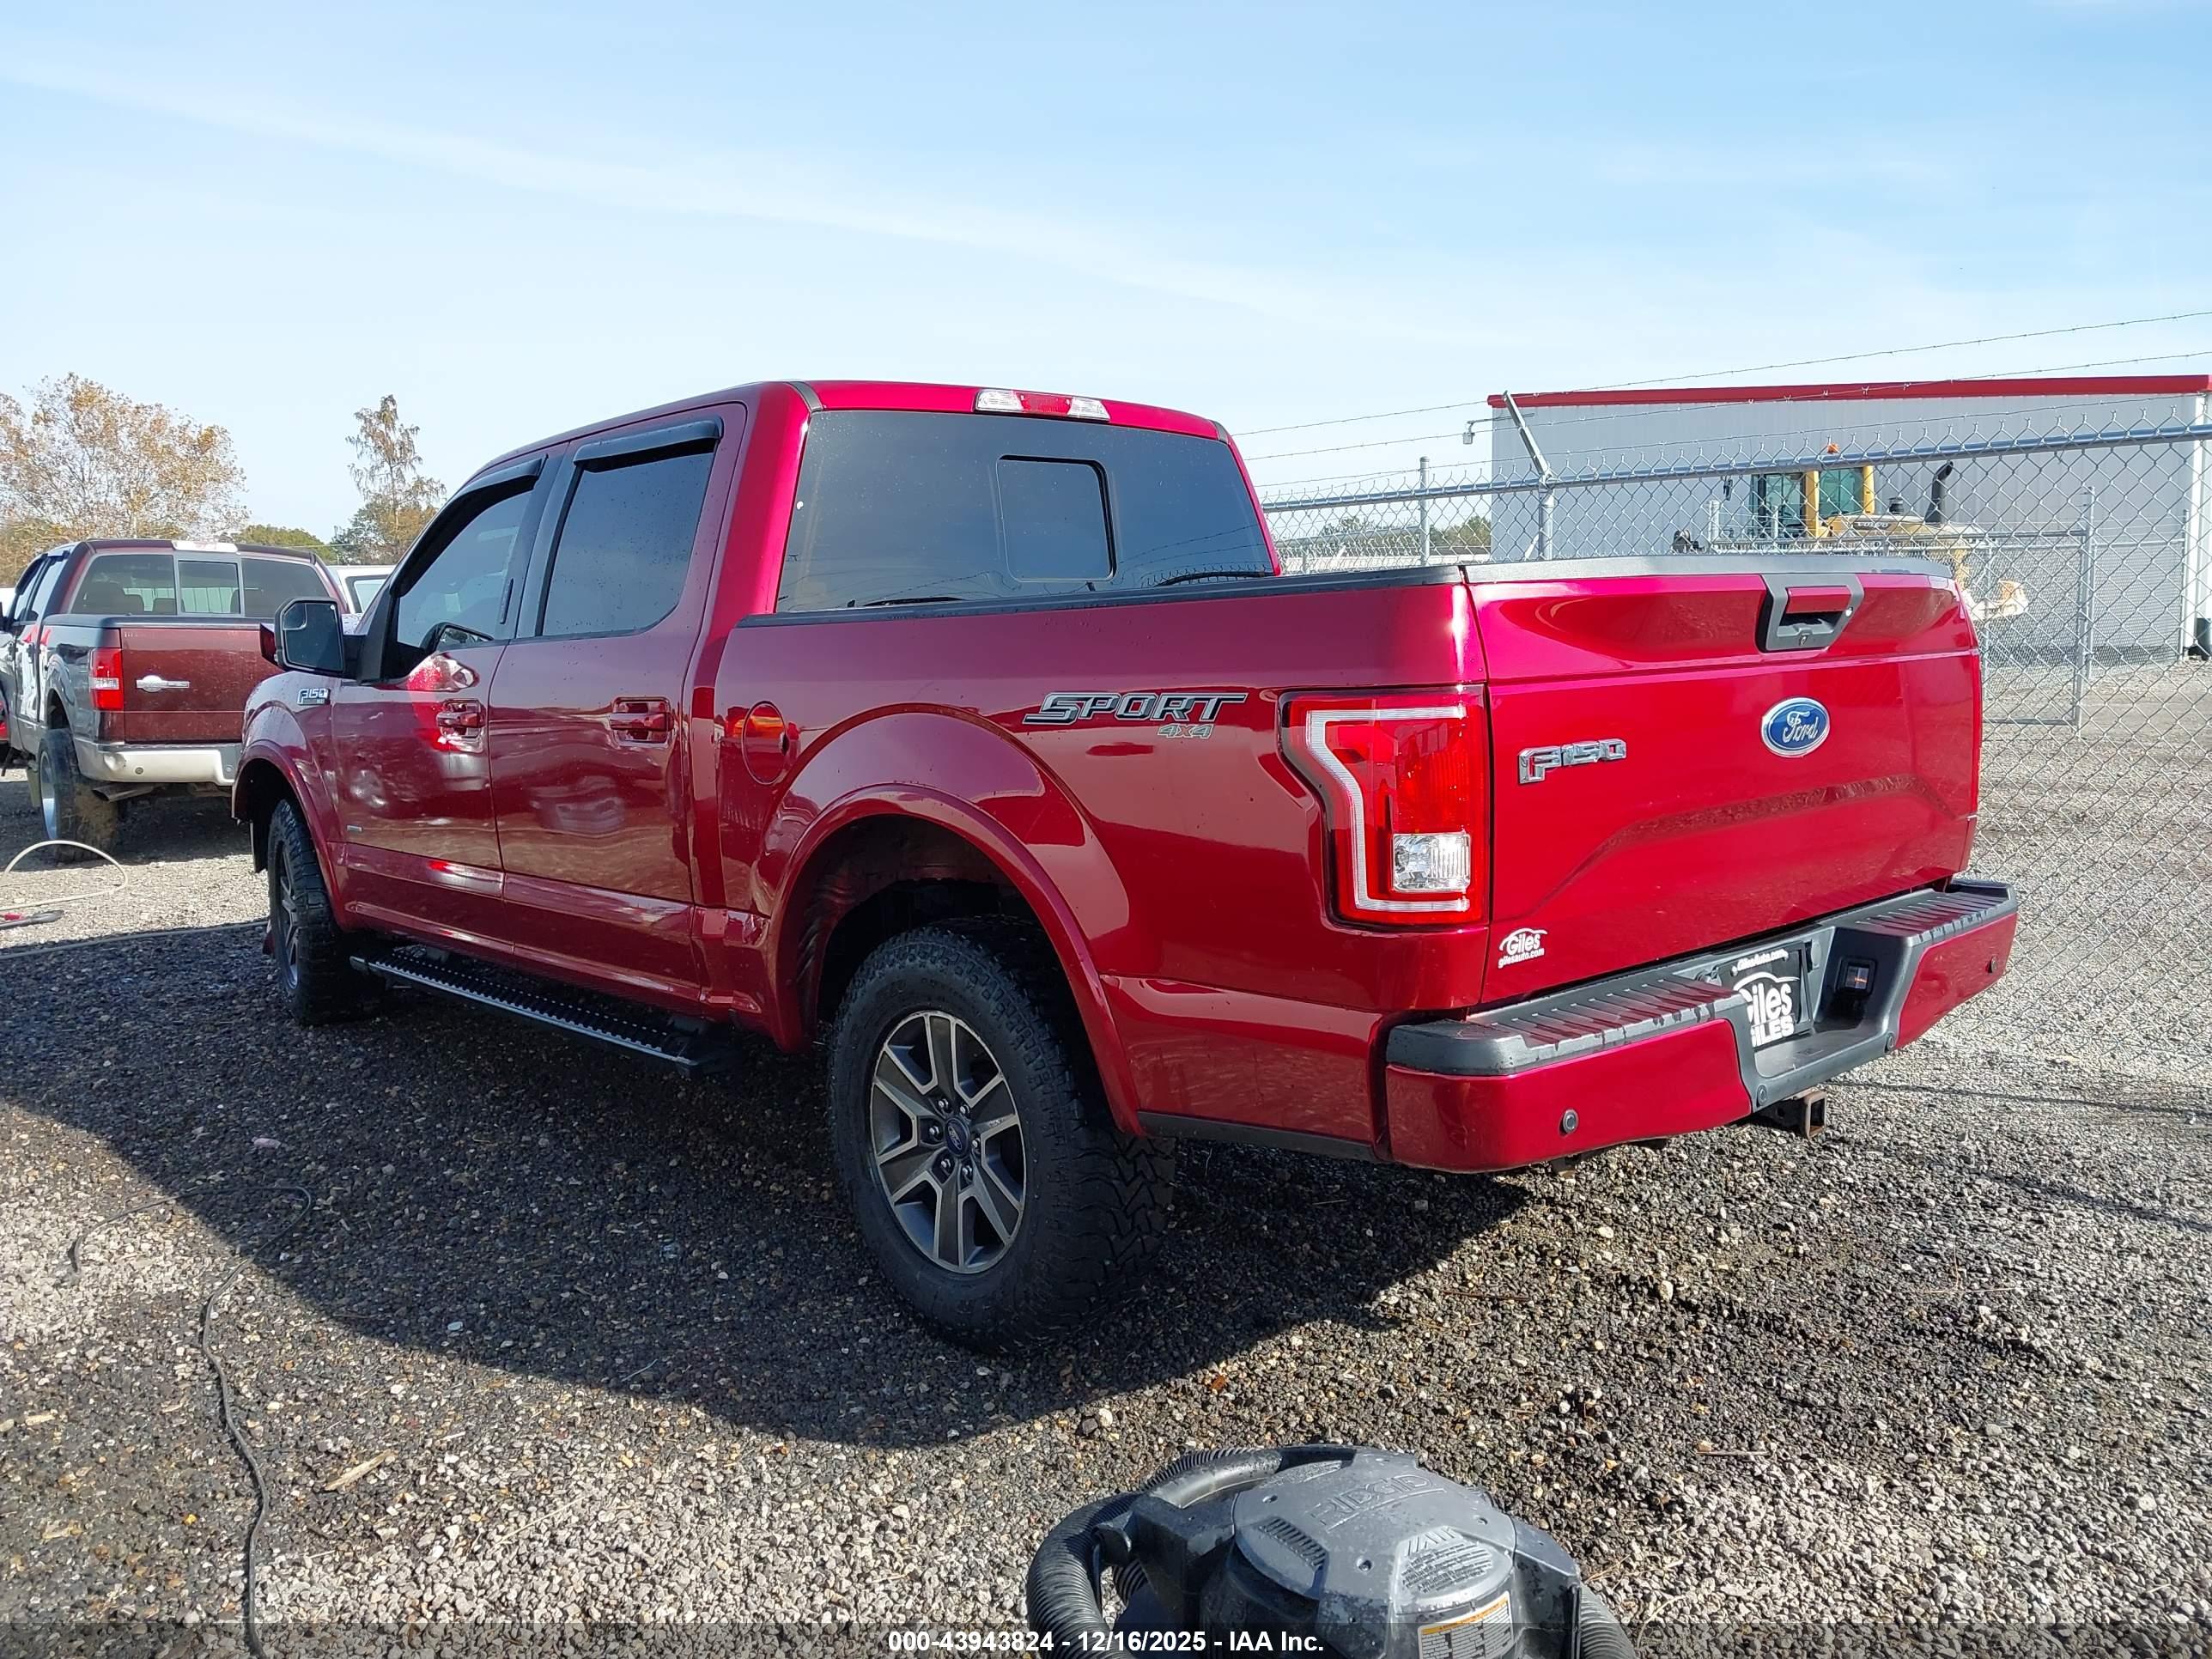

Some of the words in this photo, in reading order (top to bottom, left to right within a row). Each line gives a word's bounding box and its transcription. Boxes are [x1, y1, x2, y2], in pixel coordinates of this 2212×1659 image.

[297, 688, 329, 704] F150
[1022, 692, 1249, 725] SPORT
[1784, 710, 1820, 743] Ford
[1518, 738, 1626, 784] F150
[1506, 933, 1541, 956] Giles
[1306, 1474, 1433, 1526] RIDGID
